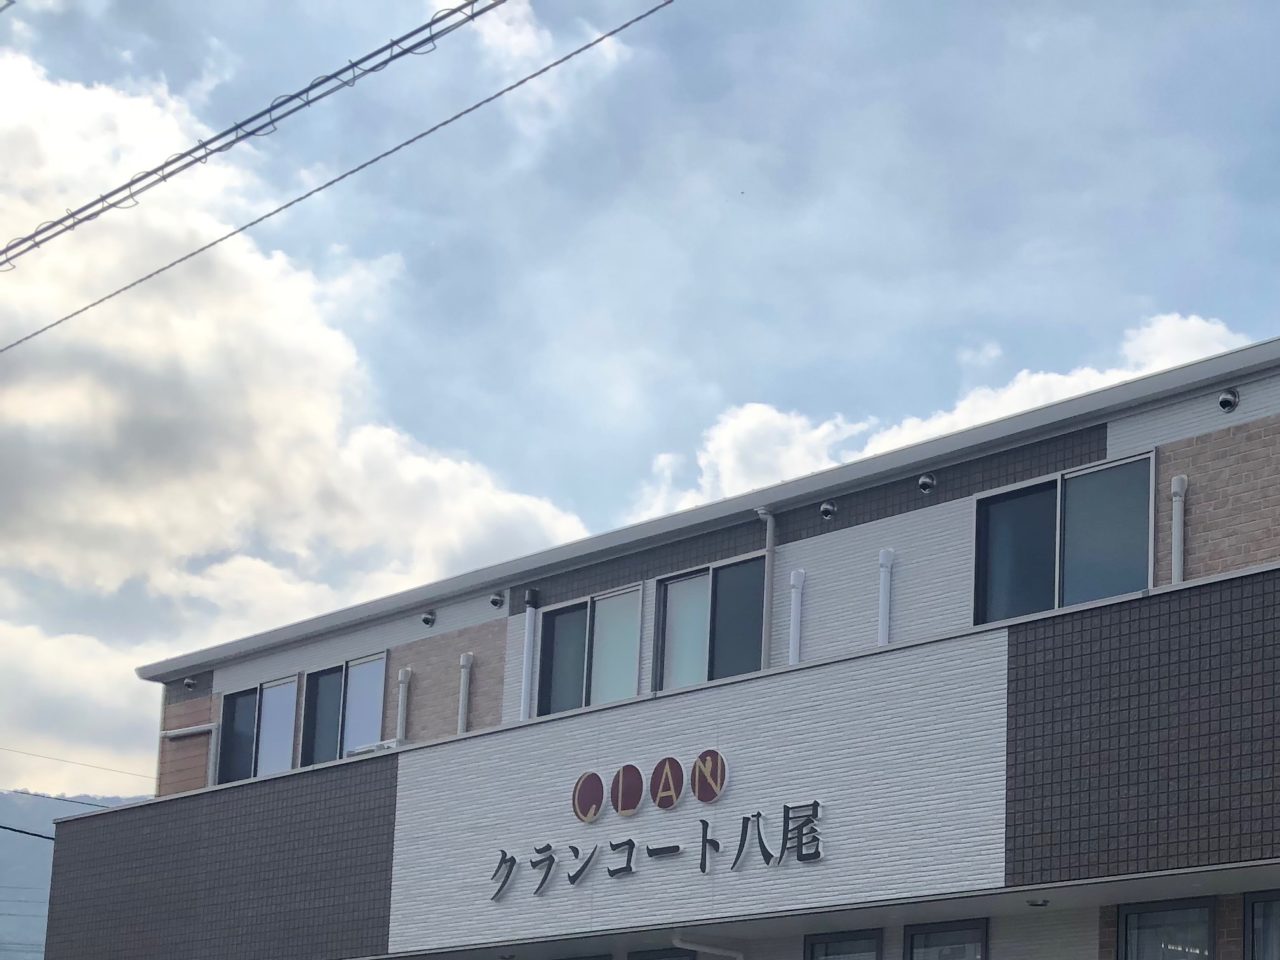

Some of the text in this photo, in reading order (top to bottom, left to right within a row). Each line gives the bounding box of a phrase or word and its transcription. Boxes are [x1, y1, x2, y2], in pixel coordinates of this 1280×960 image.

[490, 800, 822, 901] クランコート八尾
